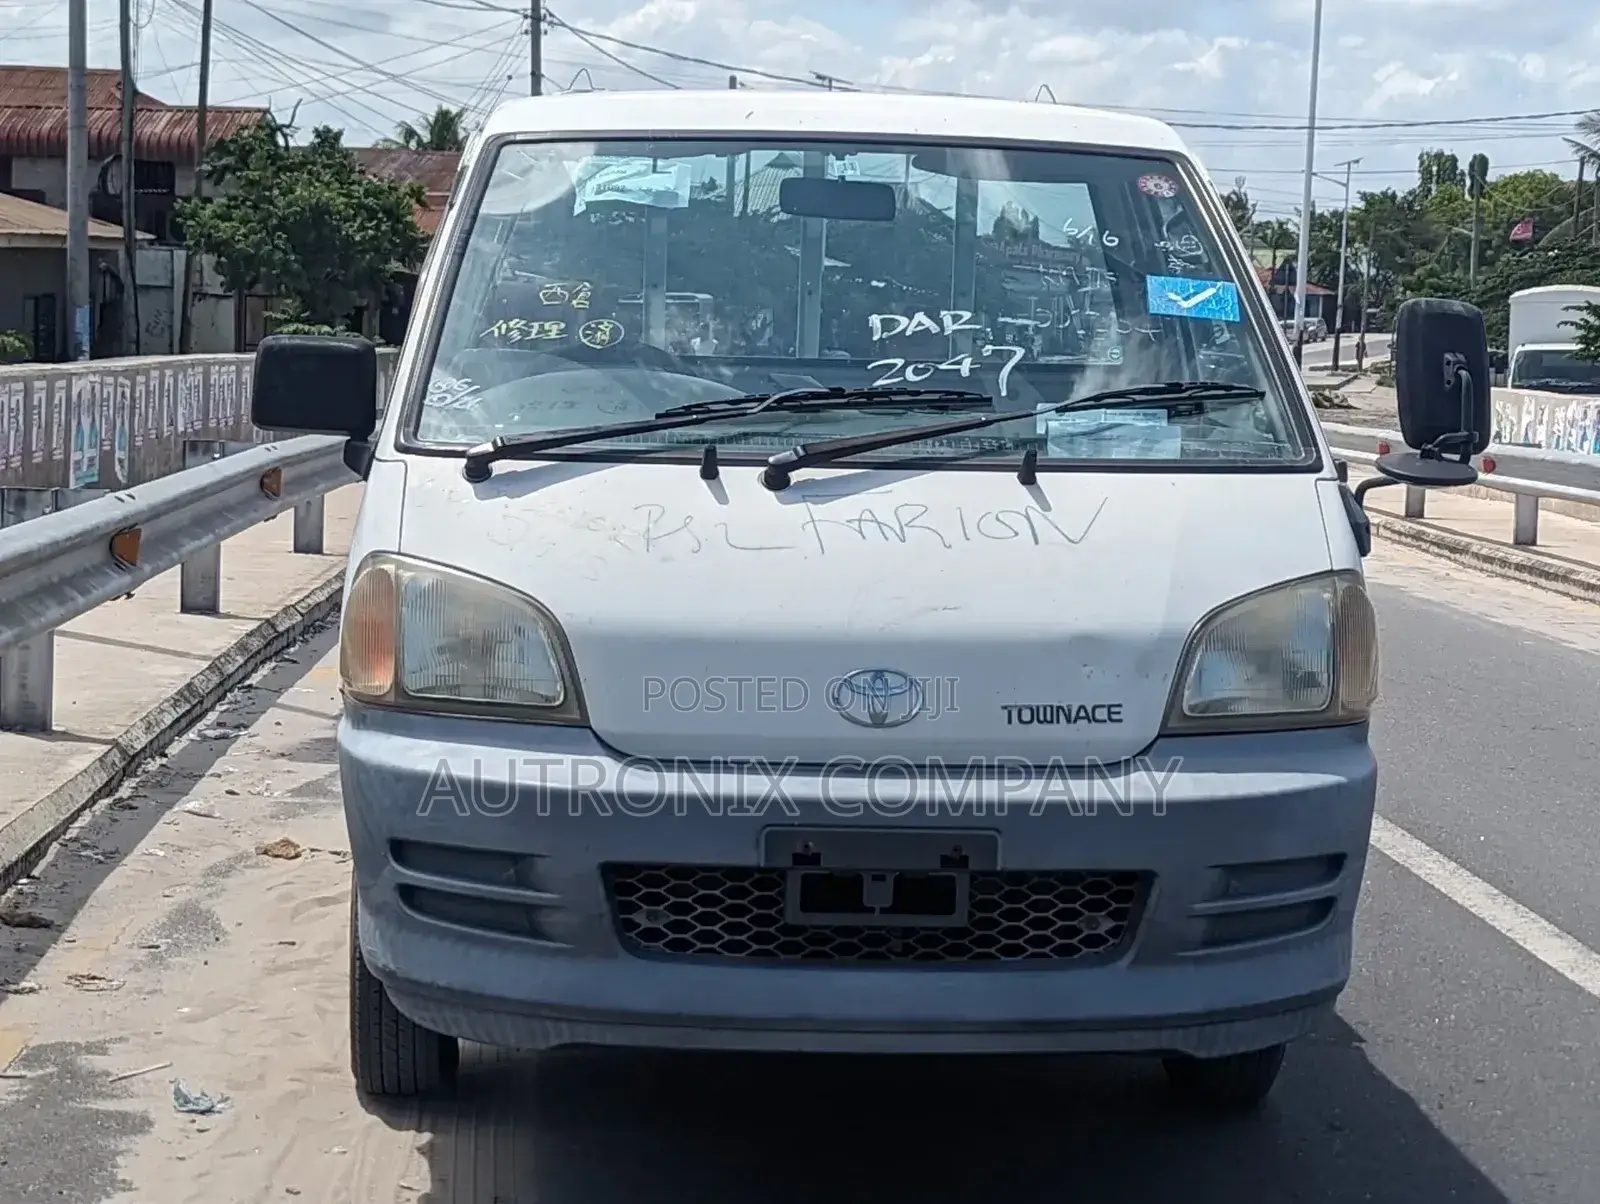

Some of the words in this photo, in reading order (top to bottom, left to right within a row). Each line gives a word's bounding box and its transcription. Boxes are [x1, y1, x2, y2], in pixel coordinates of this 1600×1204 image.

[479, 318, 569, 345] 修理
[868, 310, 982, 341] DAR
[867, 344, 1027, 397] 2047
[1000, 703, 1124, 725] TOWNACE
